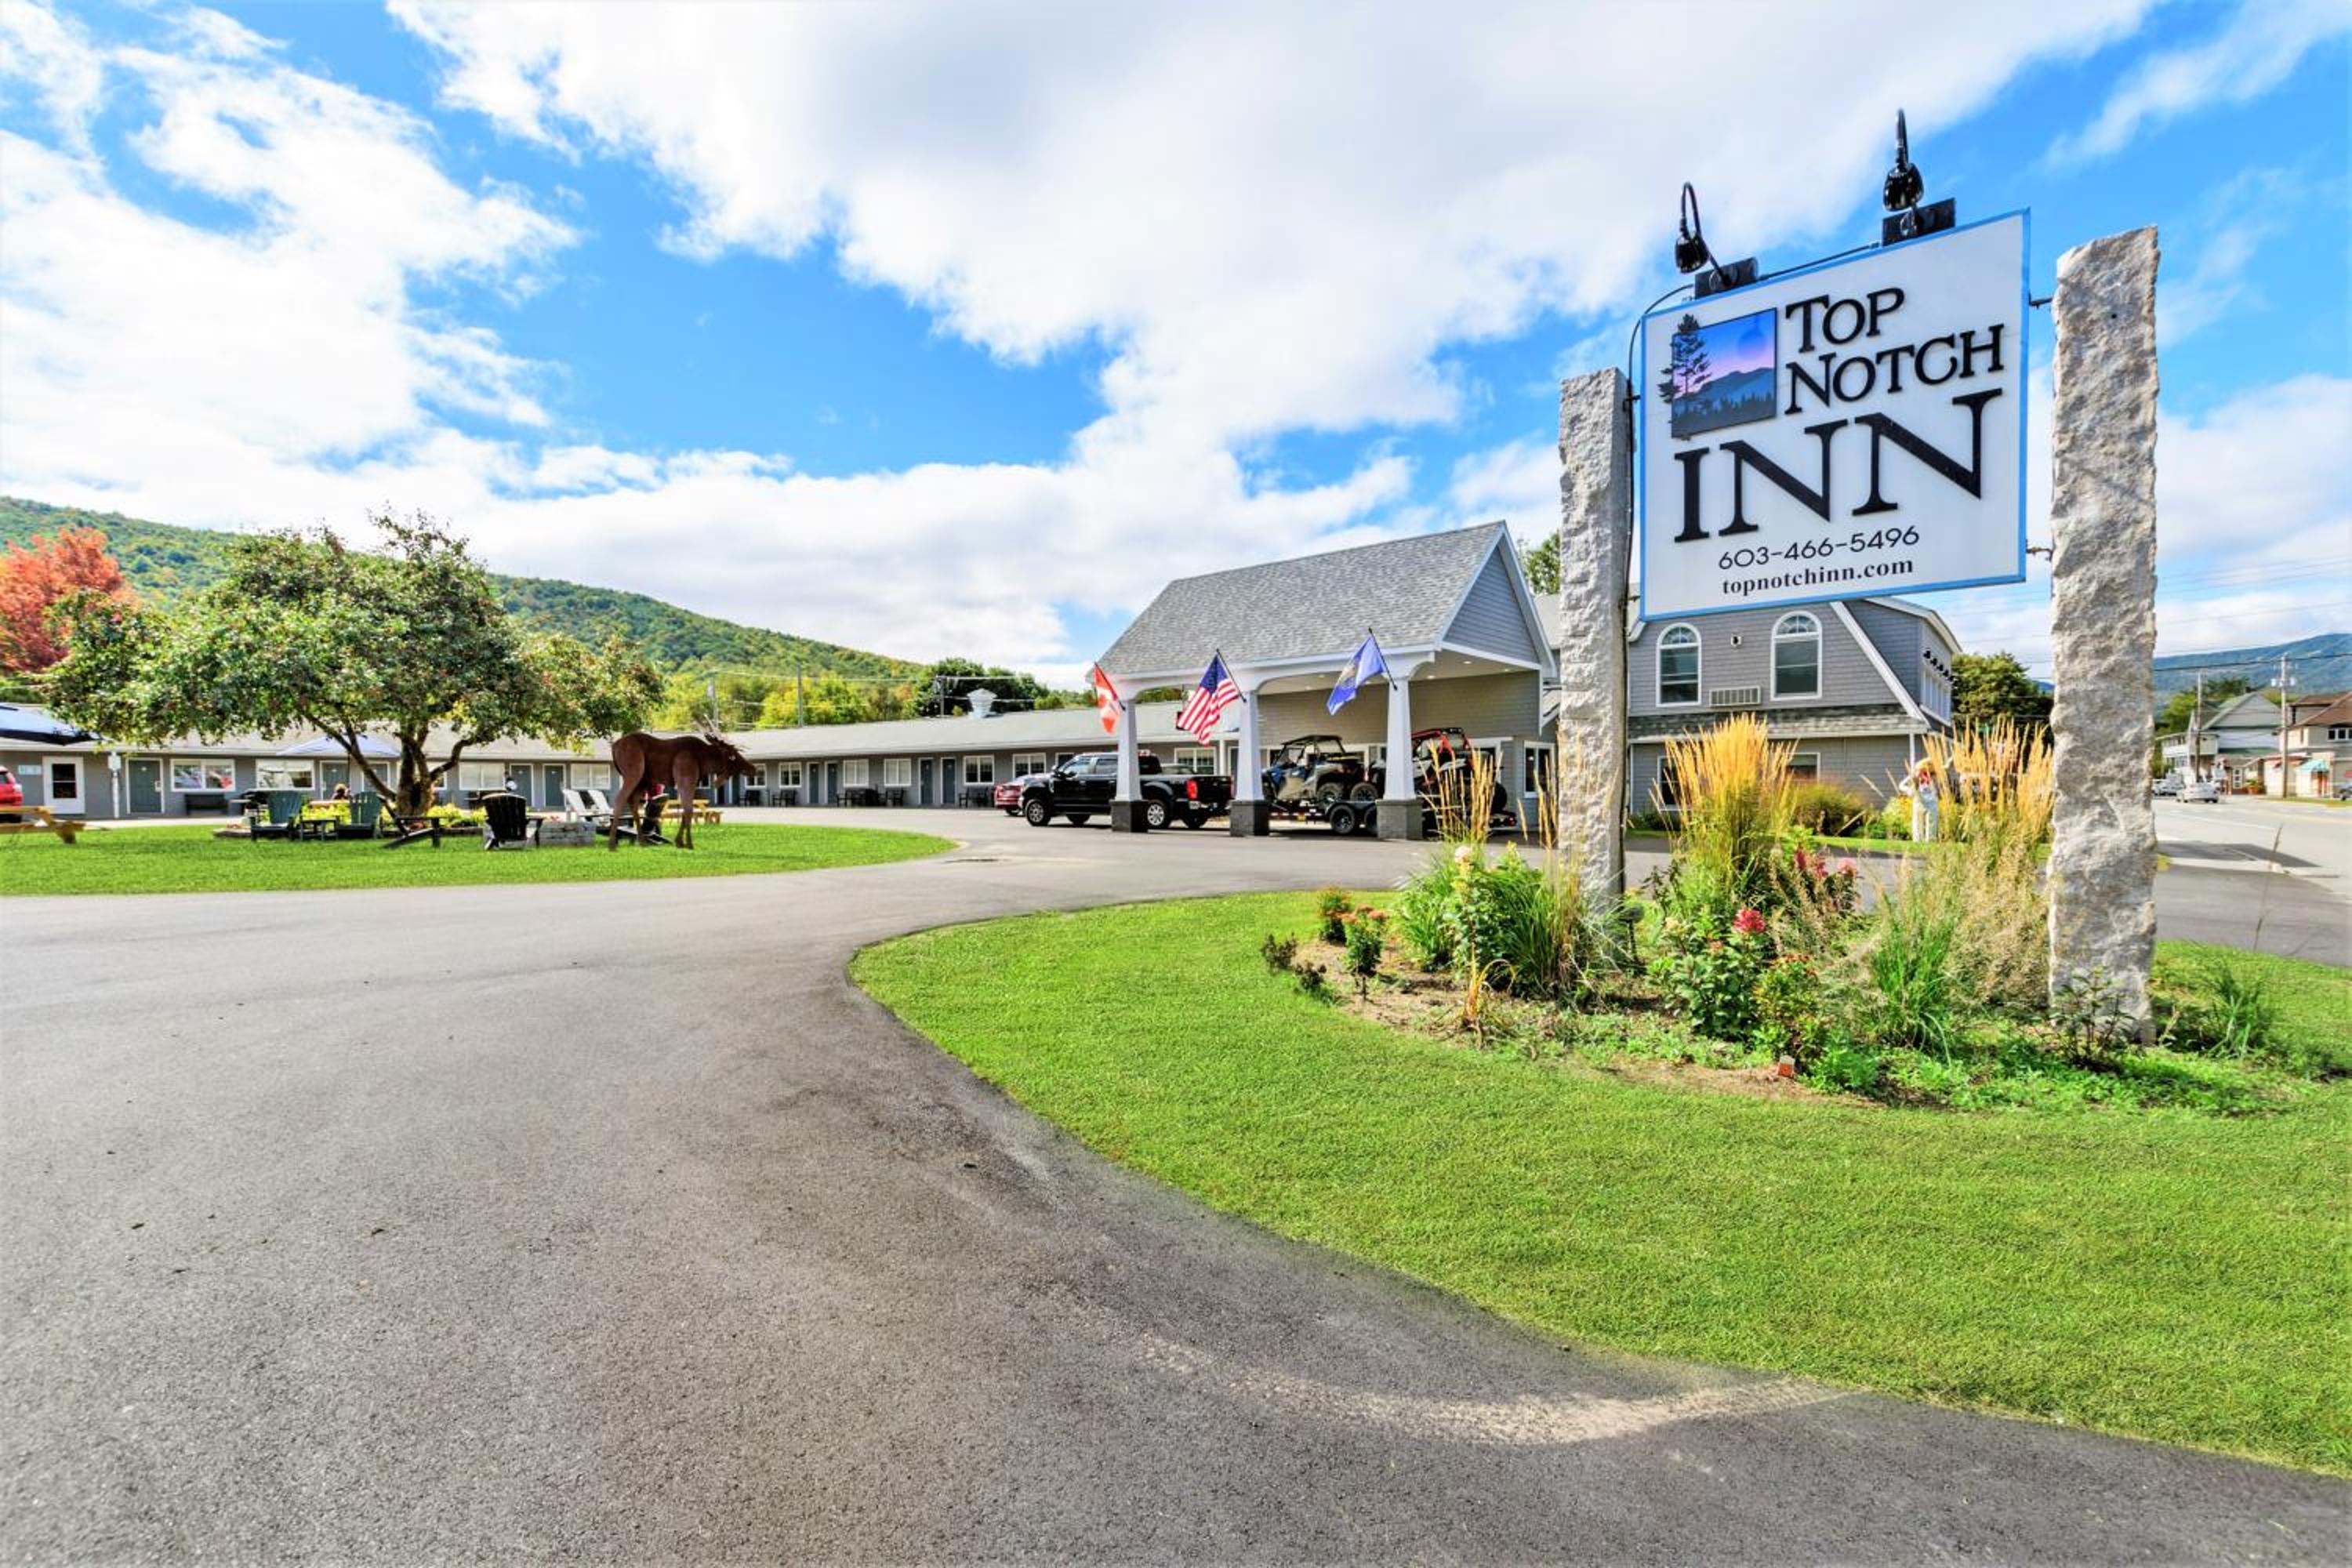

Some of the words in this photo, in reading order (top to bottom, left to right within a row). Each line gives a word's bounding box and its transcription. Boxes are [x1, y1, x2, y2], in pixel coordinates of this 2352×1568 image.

[1785, 287, 1905, 354] TOP
[1784, 323, 2005, 416] NOTCH
[1674, 387, 2003, 543] INN
[1719, 524, 1920, 570] 603-466-5496
[1722, 560, 1914, 597] topnotchinn.com
